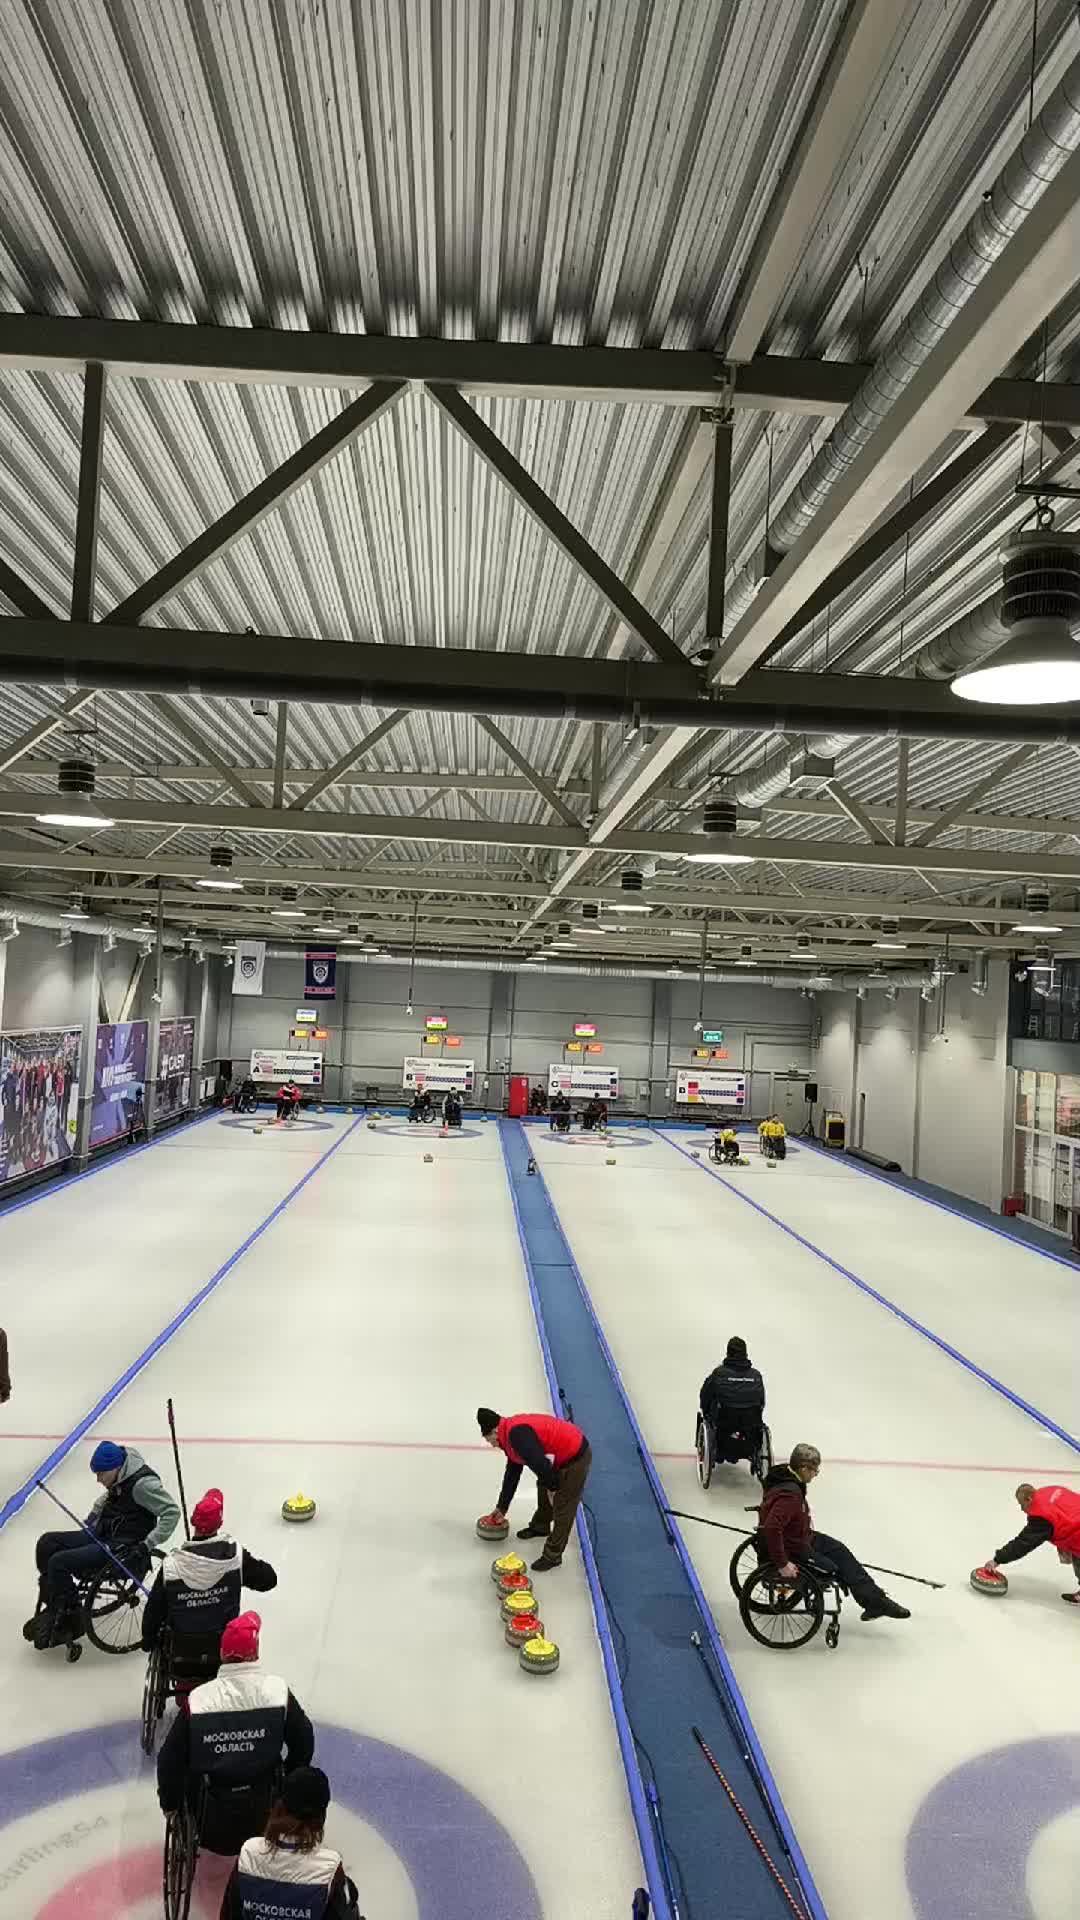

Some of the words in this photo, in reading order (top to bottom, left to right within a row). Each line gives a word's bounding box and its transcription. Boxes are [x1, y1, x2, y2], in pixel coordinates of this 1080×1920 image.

[177, 1586, 229, 1601] МОСКОВСКАЯ
[186, 1597, 221, 1608] ОБЛАСТЬ
[203, 1728, 266, 1744] МОСКОВСКАЯ
[214, 1742, 255, 1754] ОБЛАСТЬ
[243, 1899, 312, 1920] МОСКОВСКАЯ
